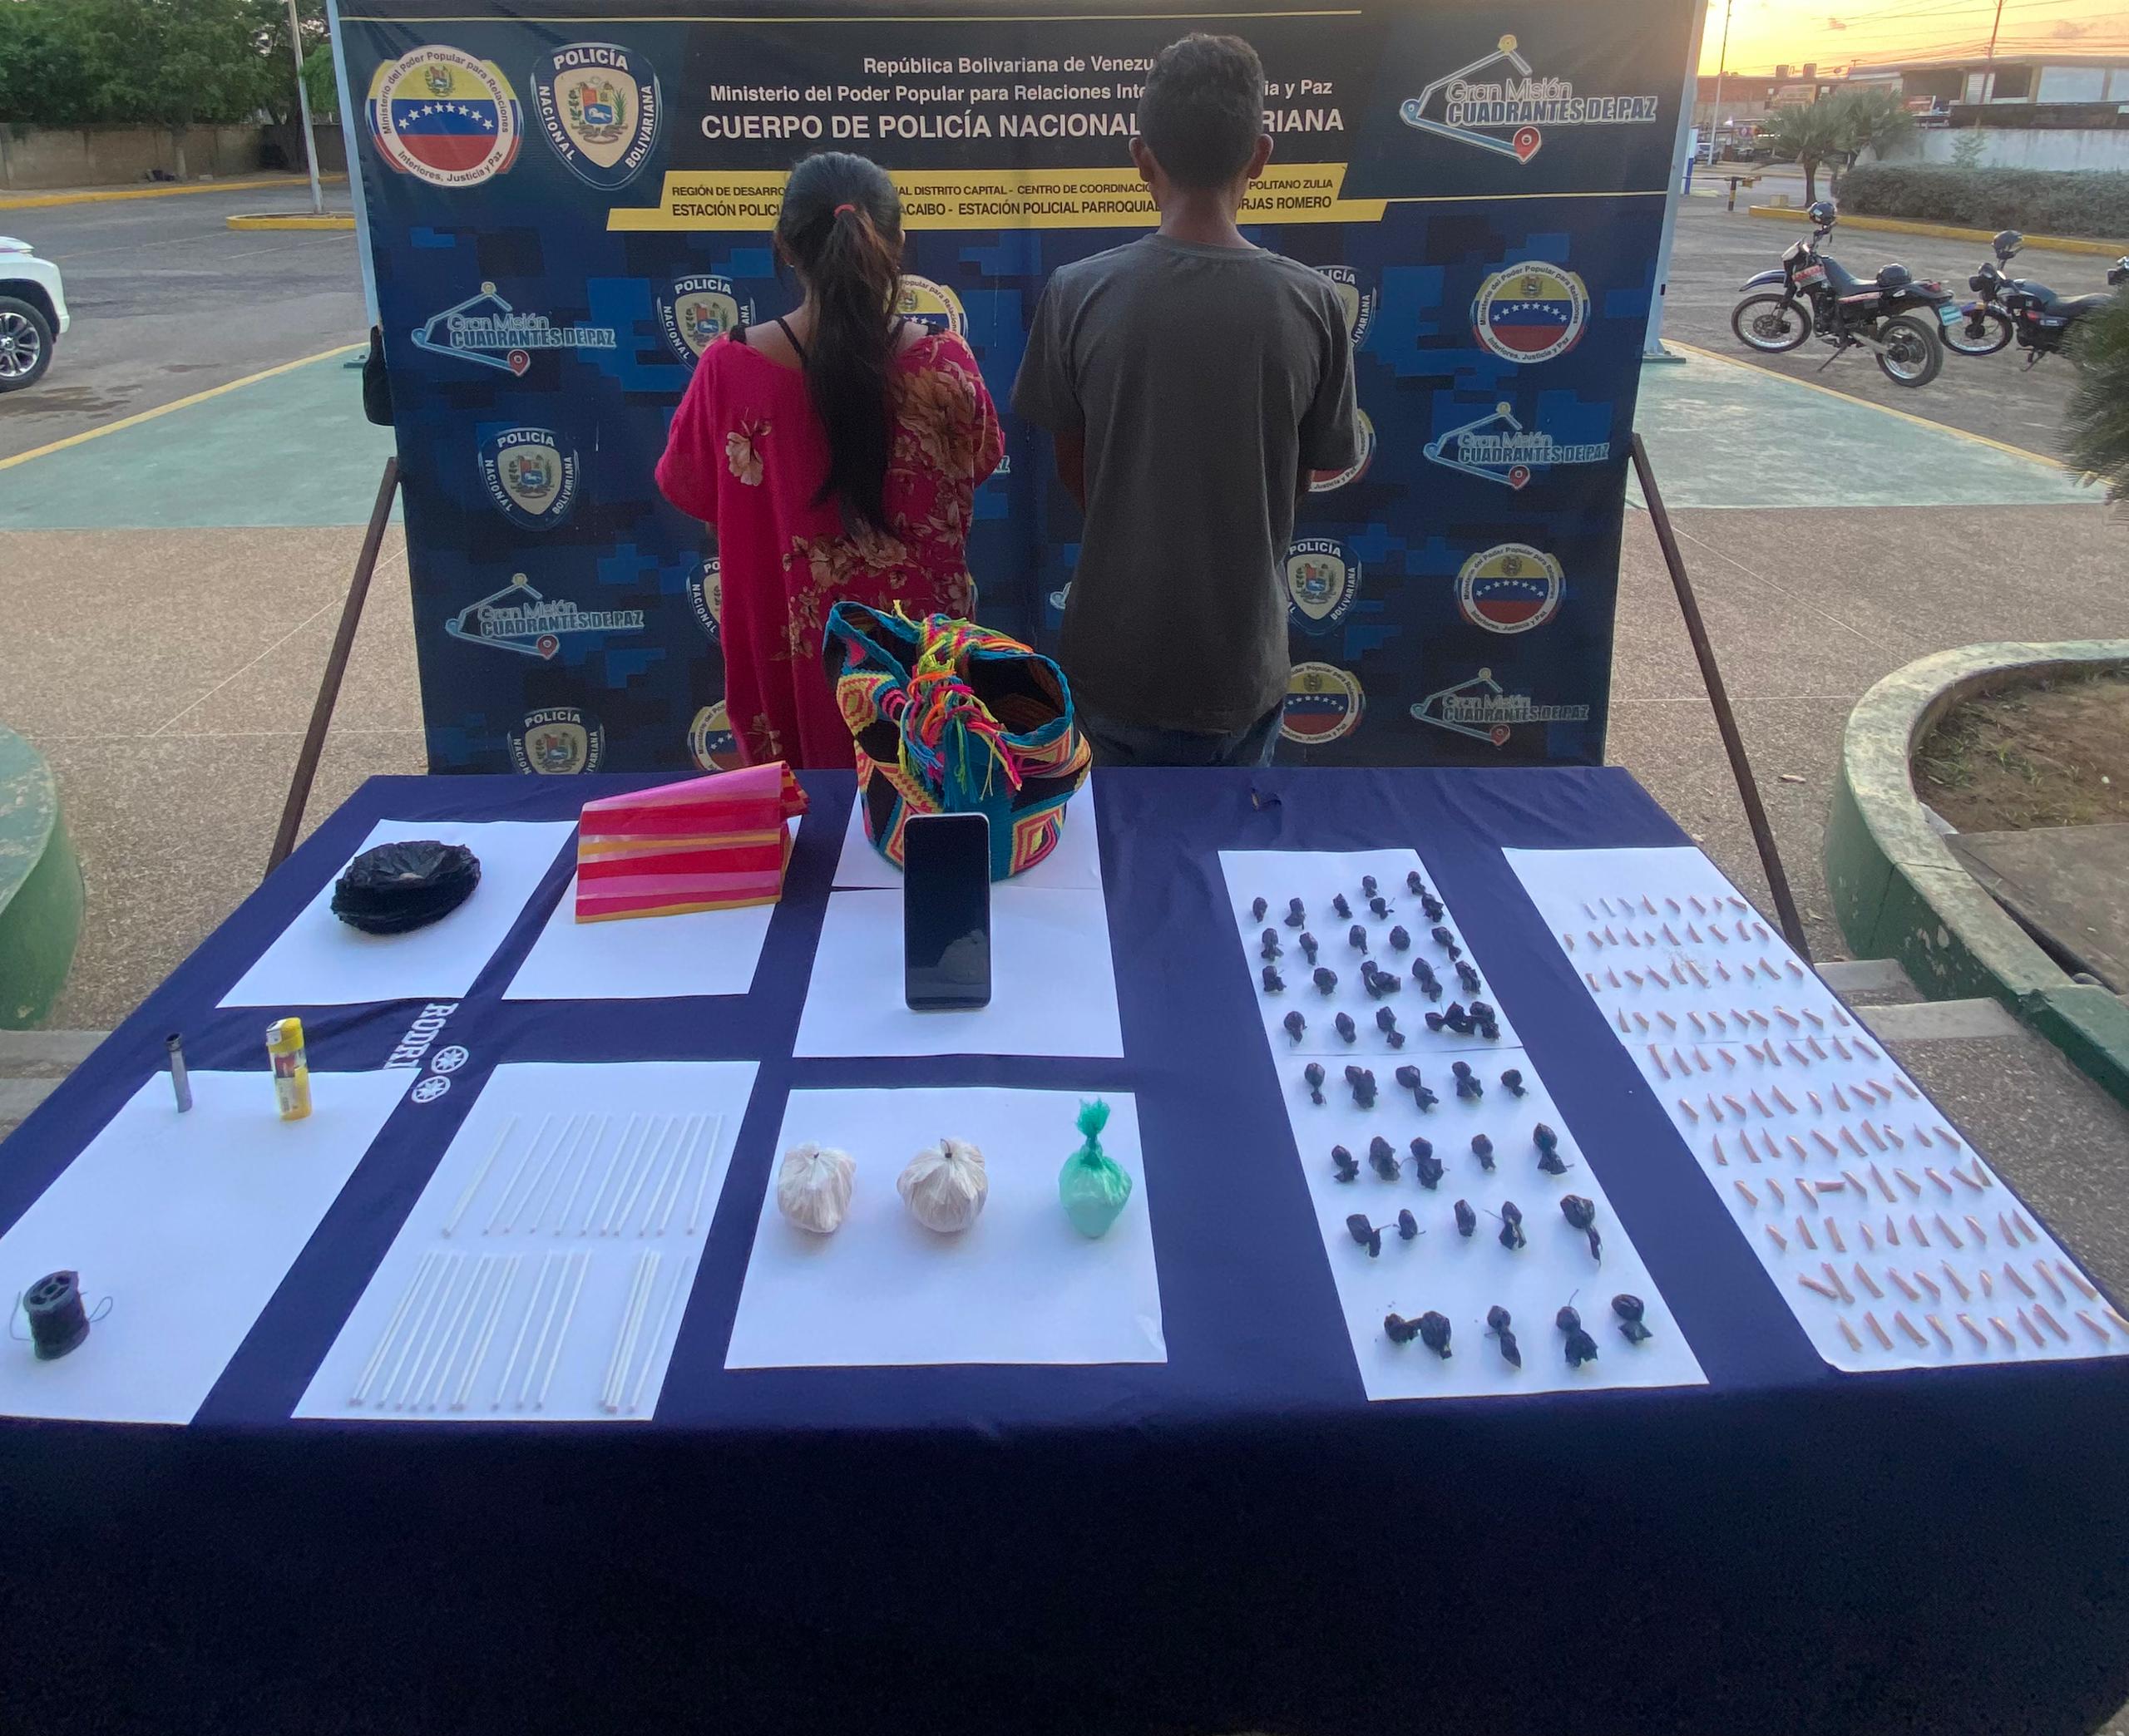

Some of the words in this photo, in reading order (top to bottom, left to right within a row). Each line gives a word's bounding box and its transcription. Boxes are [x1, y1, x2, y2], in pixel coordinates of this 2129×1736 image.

[553, 48, 629, 71] POLICÍA
[863, 57, 953, 76] República
[958, 57, 1059, 73] Bolivariana
[1064, 57, 1085, 72] de
[383, 86, 392, 135] Ministerio
[388, 69, 402, 84] del
[400, 55, 424, 72] Poder
[427, 52, 466, 65] Popular
[467, 61, 487, 79] para
[487, 78, 509, 133] Relaciones
[710, 85, 800, 101] Ministerio
[805, 85, 832, 101] del
[837, 86, 890, 101] Poder
[896, 86, 965, 105] Popular
[970, 88, 1009, 104] para
[1014, 85, 1111, 101] Relaciones
[1285, 83, 1296, 99] y
[1301, 80, 1332, 95] Paz
[1446, 79, 1502, 101] Gran
[1505, 77, 1573, 101] Misión
[539, 86, 577, 160] NACIONAL
[1446, 97, 1584, 126] CUADRANTES
[1587, 97, 1615, 122] DE
[1616, 96, 1657, 122] PAZ
[625, 86, 655, 168] BOLIVARIANA
[701, 115, 823, 139] CUERPO
[832, 115, 870, 139] DE
[879, 110, 992, 139] POLICÍA
[999, 113, 1141, 138] NACIONAL
[447, 169, 485, 182] Justicia
[485, 165, 491, 174] y
[488, 151, 503, 167] Paz
[672, 185, 714, 196] REGIÓN
[716, 187, 730, 196] DE
[914, 186, 961, 195] DISTRITO
[963, 185, 1007, 195] CAPITAL
[1017, 185, 1060, 195] CENTRO
[1064, 185, 1077, 194] DE
[1303, 180, 1333, 189] ZULIA
[672, 200, 736, 216] ESTACIÓN
[958, 199, 1020, 215] ESTACIÓN
[1023, 201, 1079, 215] POLICIAL
[1082, 200, 1161, 214] PARROQUIAL
[1277, 196, 1331, 209] ROMERO
[674, 279, 732, 294] POLICÍA
[929, 287, 944, 298] para
[1479, 290, 1492, 325] Ministerio
[1491, 279, 1501, 290] del
[1501, 268, 1523, 281] Poder
[1525, 265, 1555, 275] Popular
[1555, 274, 1571, 286] para
[1569, 284, 1580, 324] Relaciones
[447, 313, 492, 331] Gran
[493, 313, 549, 330] Misión
[664, 306, 689, 359] NACIONAL
[451, 328, 562, 348] CUADRANTES
[563, 328, 585, 348] DE
[585, 328, 616, 348] PAZ
[1522, 350, 1552, 360] Justicia
[1556, 337, 1569, 348] Paz
[1459, 446, 1563, 464] CUADRANTES
[1563, 445, 1583, 463] DE
[1583, 442, 1610, 461] PAZ
[485, 459, 513, 511] NACIONAL
[552, 456, 575, 515] BOLIVARIANA
[692, 584, 718, 634] NACIONAL
[481, 613, 589, 638] CUADRANTES
[590, 611, 612, 629] DE
[613, 610, 645, 629] PAZ
